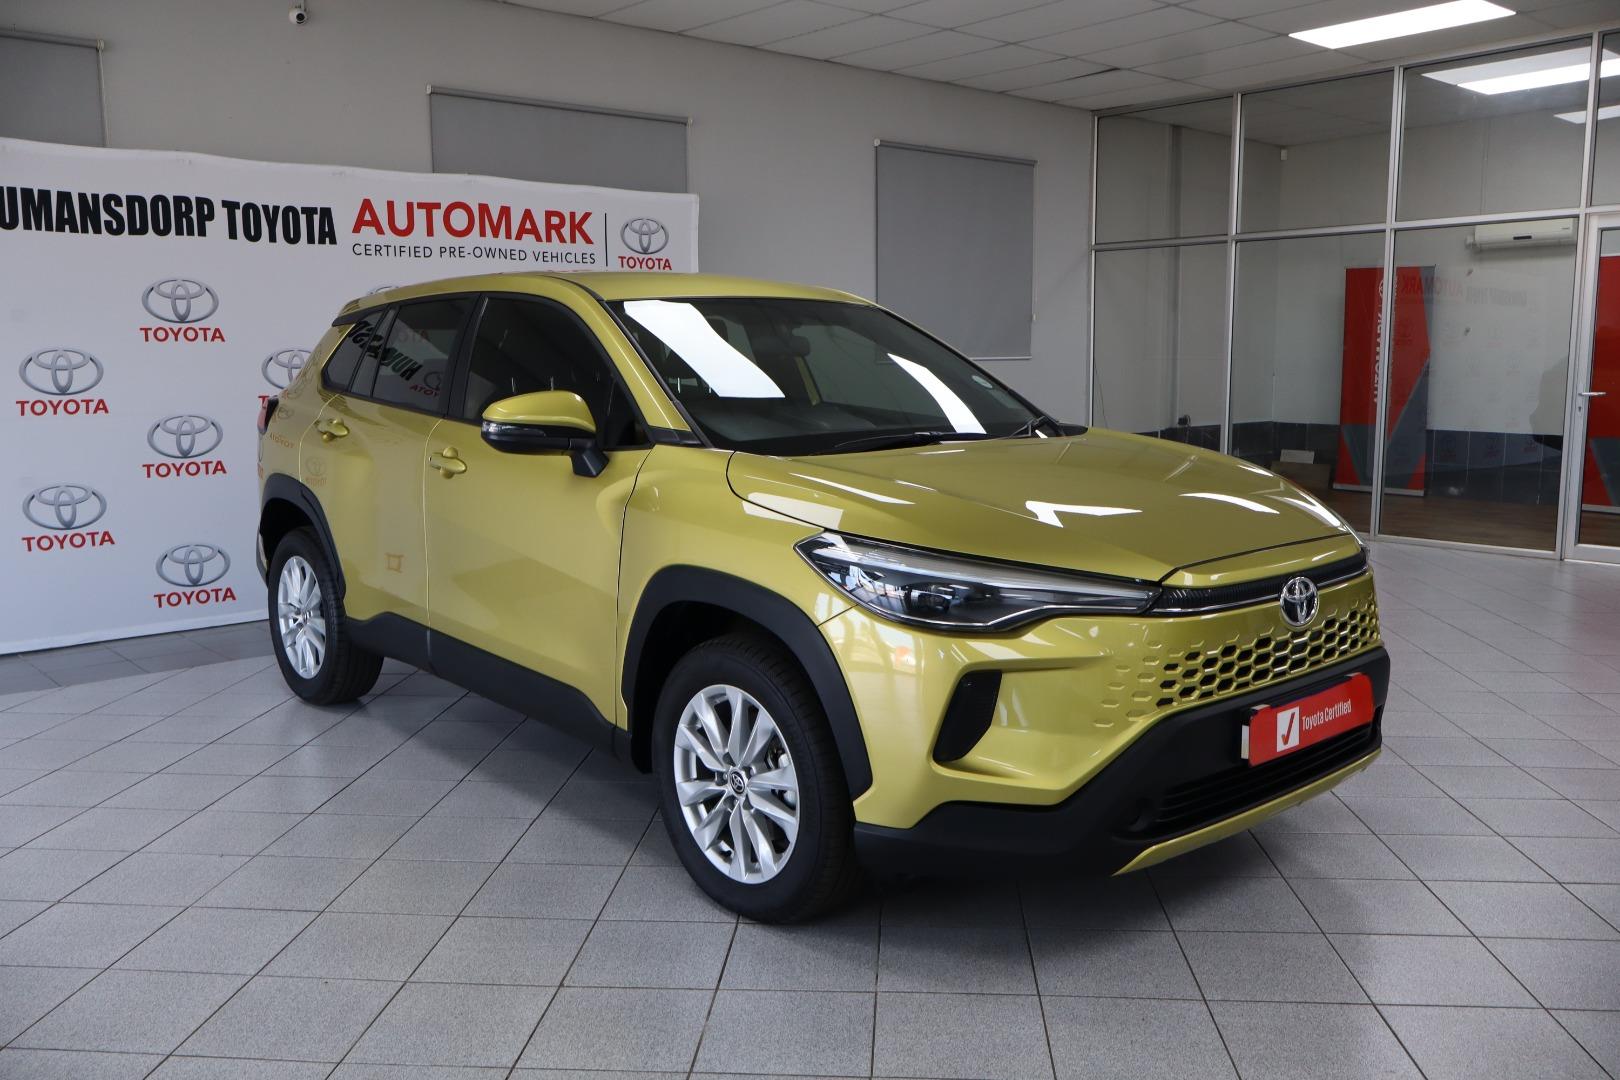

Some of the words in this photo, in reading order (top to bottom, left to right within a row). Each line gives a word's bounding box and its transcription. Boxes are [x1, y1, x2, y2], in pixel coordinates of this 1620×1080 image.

[222, 199, 338, 245] TOYOTA
[351, 197, 594, 246] AUTOMARK
[352, 243, 433, 259] CERTIFIED
[439, 246, 527, 262] PRE-OWNED
[532, 250, 596, 265] VEHICLES
[617, 255, 673, 271] TOYOTA
[140, 326, 225, 343] TOYOTA
[16, 399, 109, 417] TOYOTA
[142, 460, 226, 478] TOYOTA
[23, 531, 115, 553] TOYOTA
[154, 588, 236, 608] TOYOTA
[1302, 711, 1324, 731] Toyota
[1324, 698, 1352, 722] Certified
